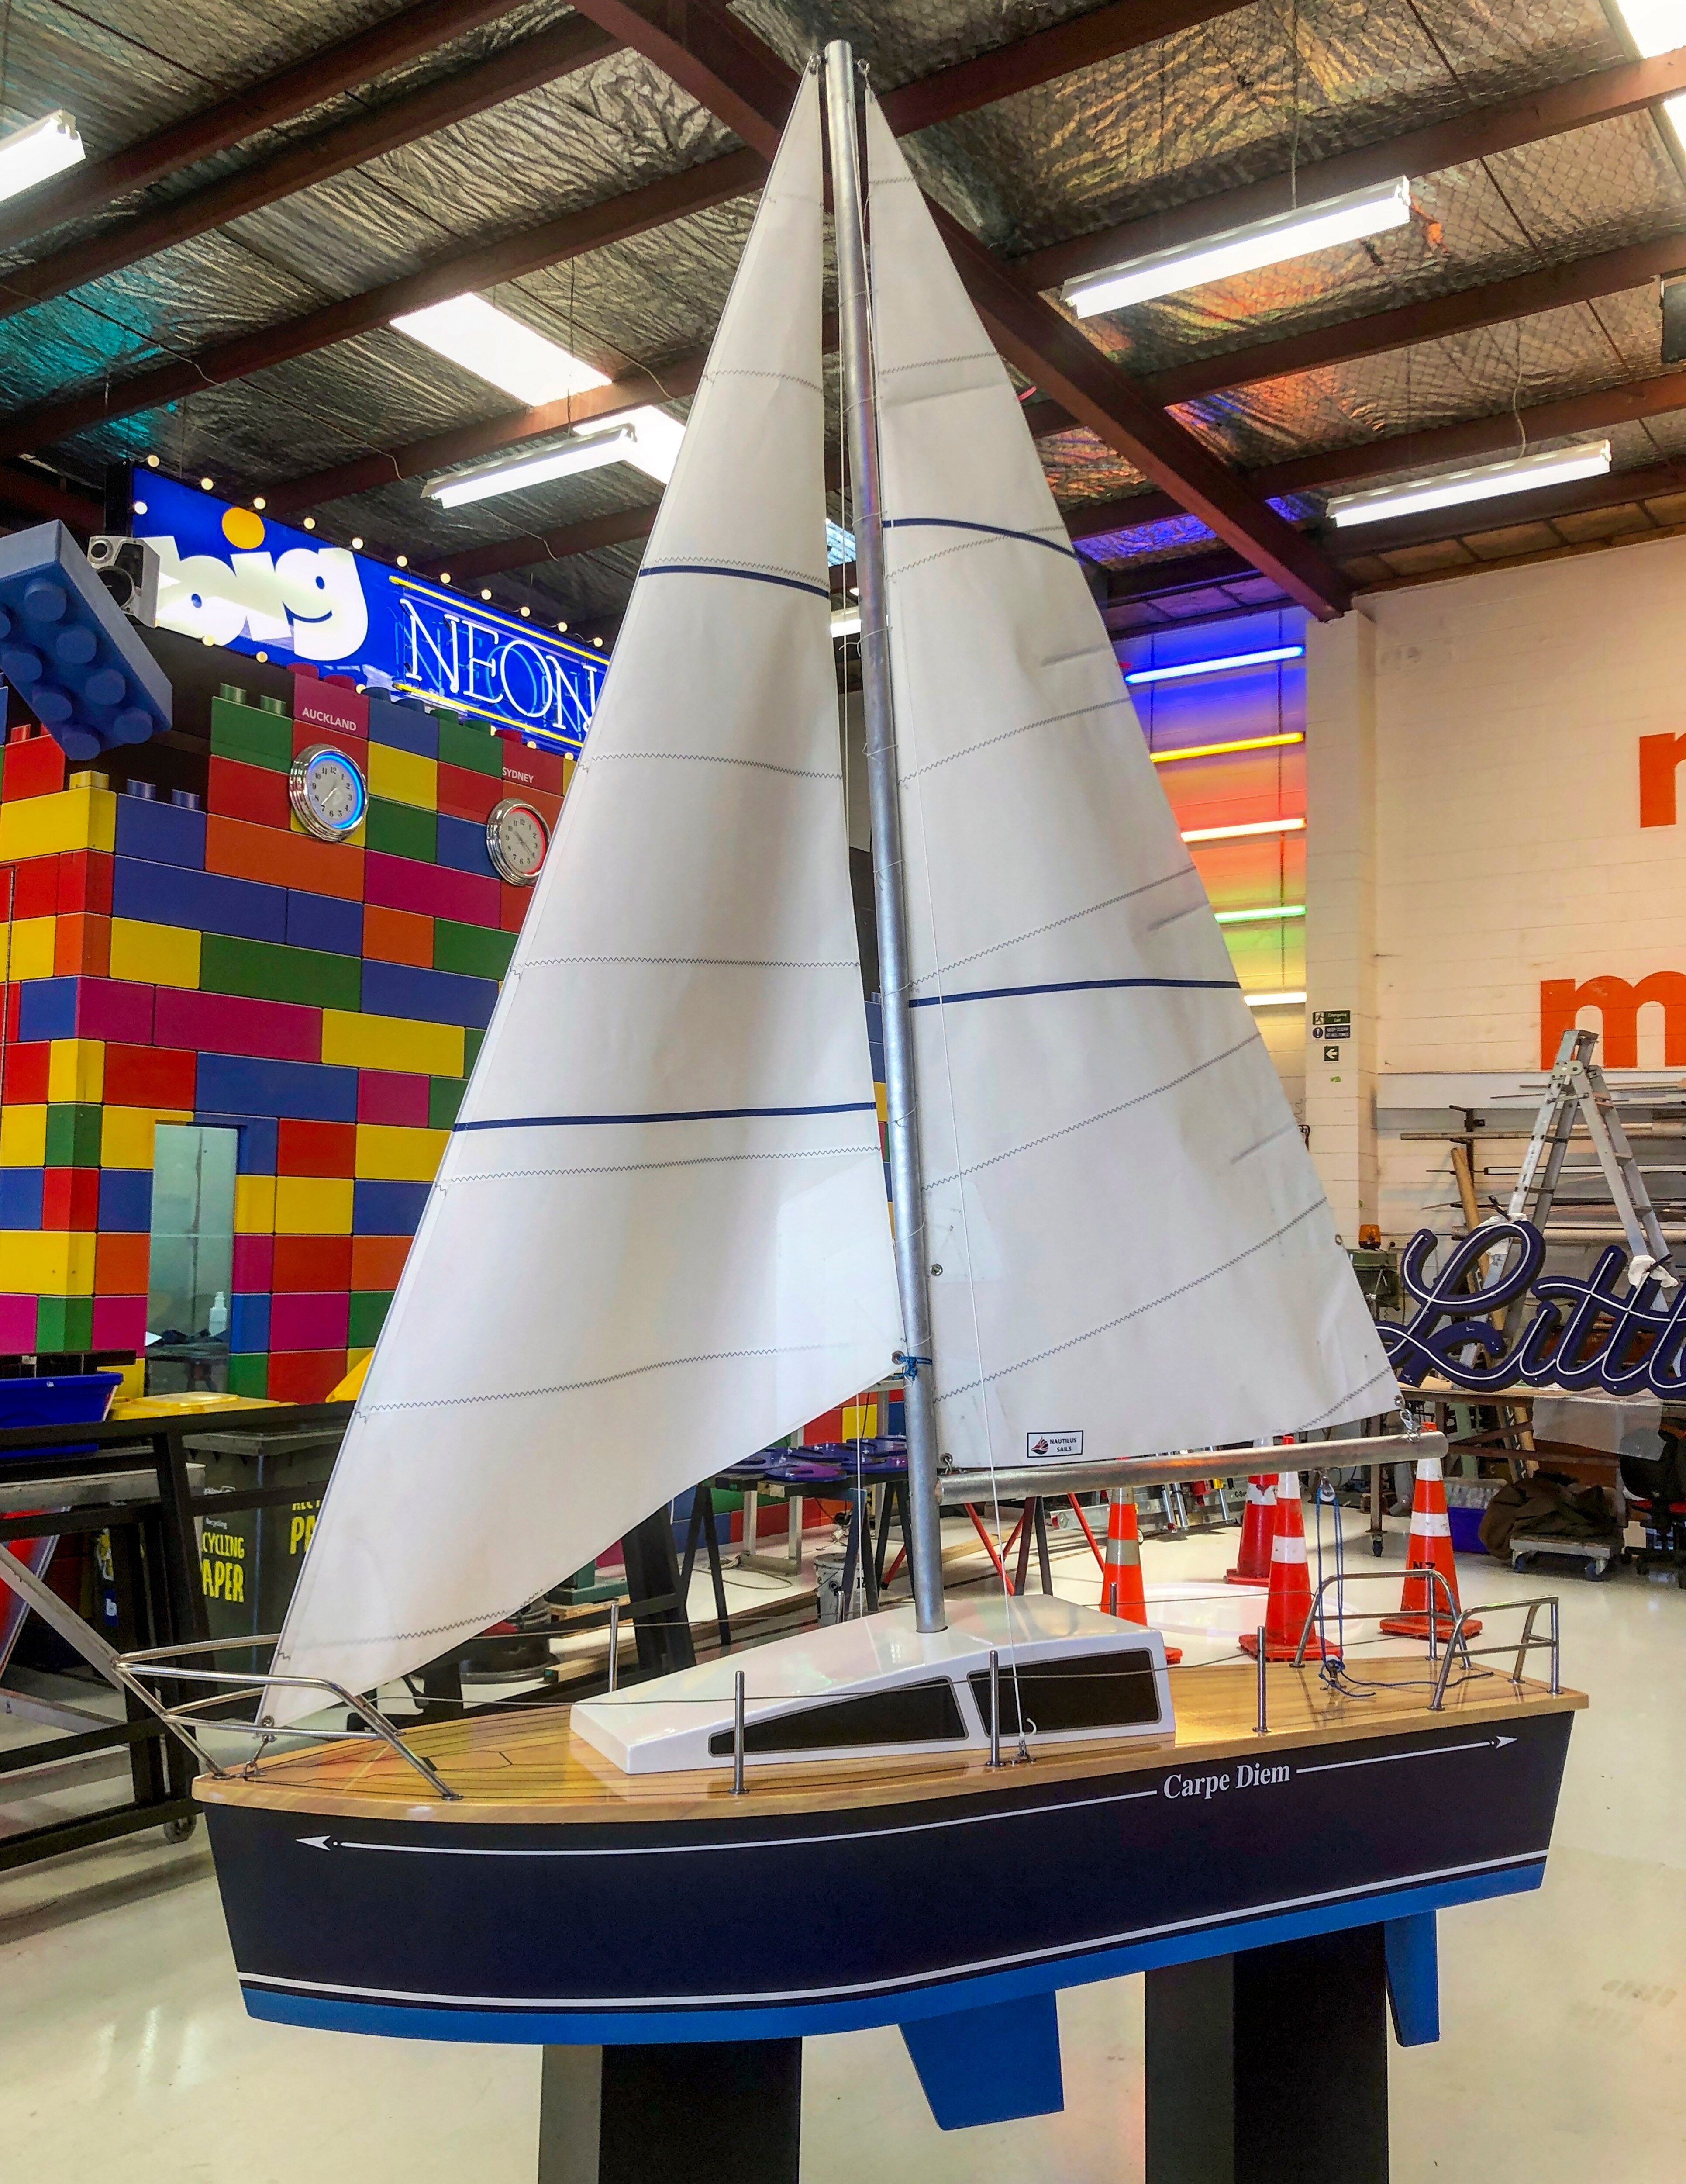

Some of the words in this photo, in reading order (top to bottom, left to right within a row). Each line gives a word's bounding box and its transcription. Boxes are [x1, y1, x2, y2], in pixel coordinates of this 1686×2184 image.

[139, 506, 368, 661] big
[400, 599, 597, 733] NEON
[302, 707, 357, 731] AUCKLAND
[502, 767, 534, 783] SYDNEY
[202, 1532, 245, 1559] CYCLING
[202, 1558, 244, 1603] APER
[1163, 1773, 1230, 1800] Carpe
[1235, 1763, 1290, 1789] Diem
